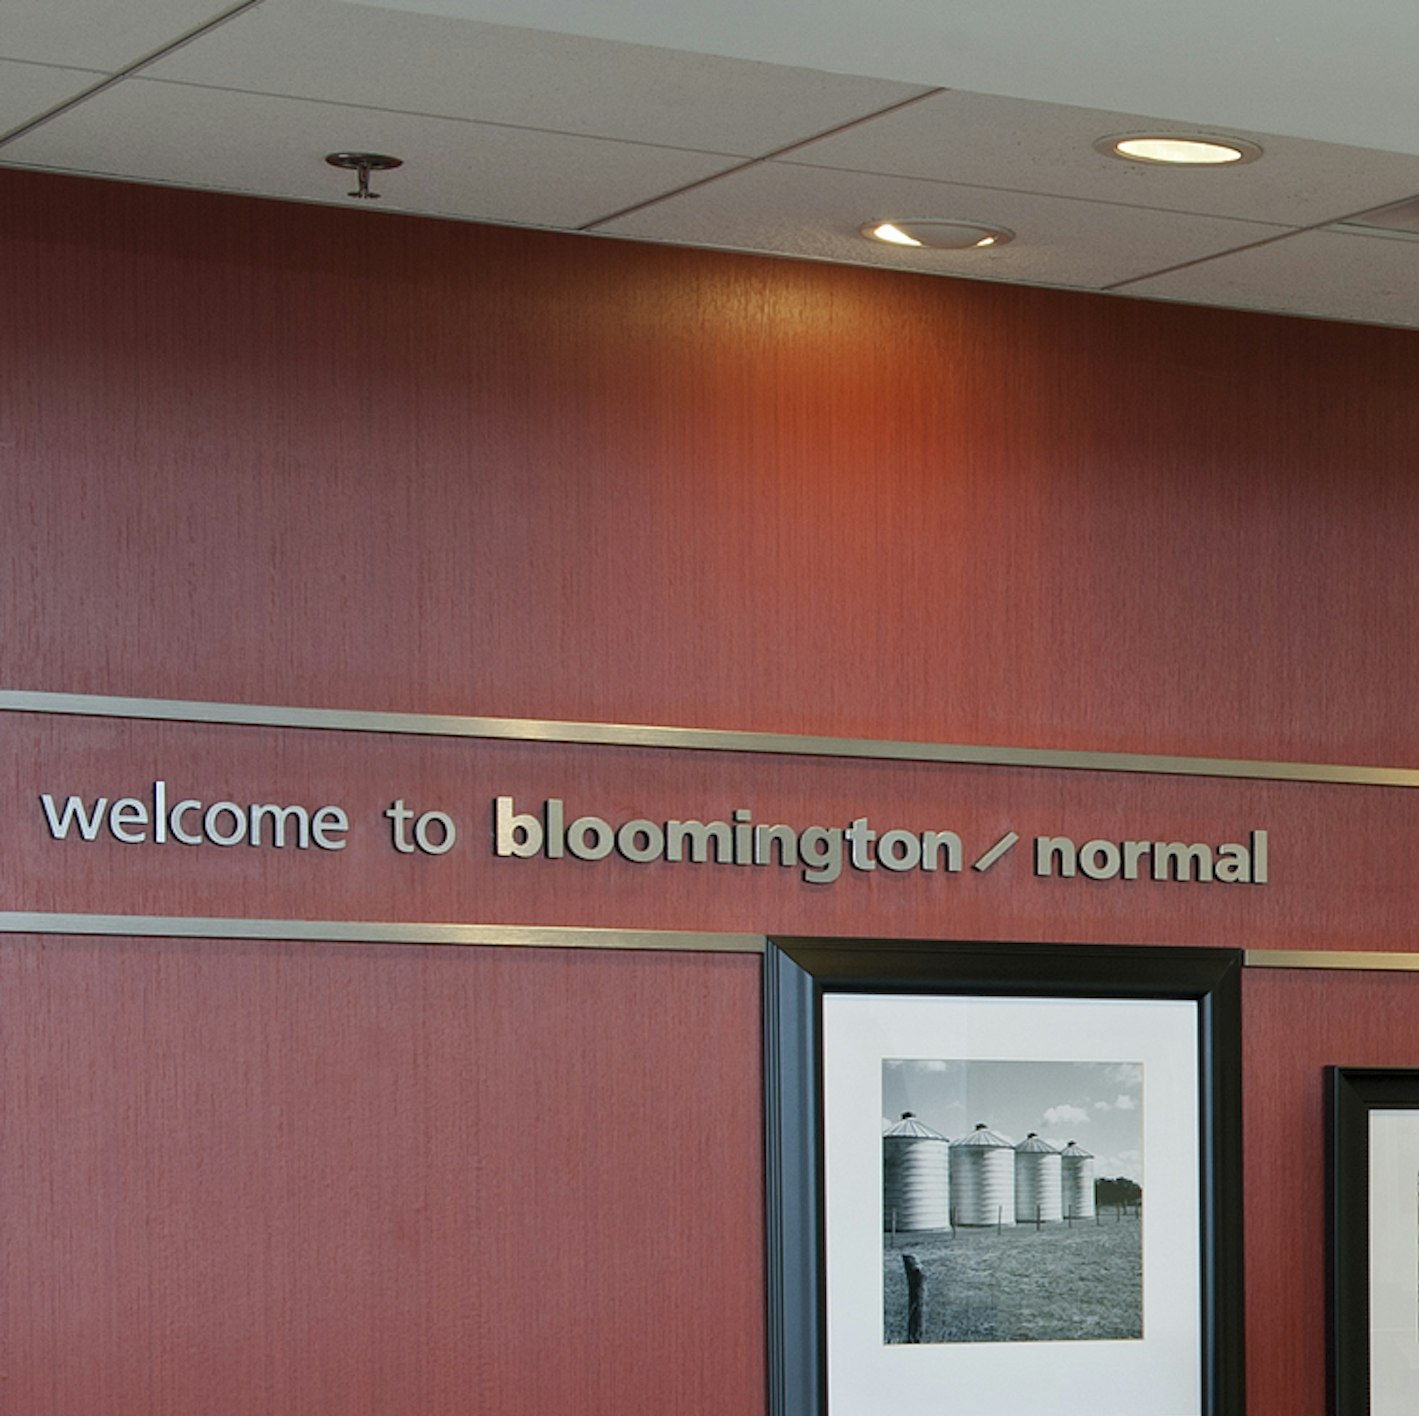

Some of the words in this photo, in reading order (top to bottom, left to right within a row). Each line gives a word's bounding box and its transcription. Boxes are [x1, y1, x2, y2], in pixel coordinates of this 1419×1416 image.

[38, 780, 349, 850] welcome
[384, 799, 457, 855] to
[492, 796, 963, 884] bloomington
[1033, 829, 1269, 884] normal
